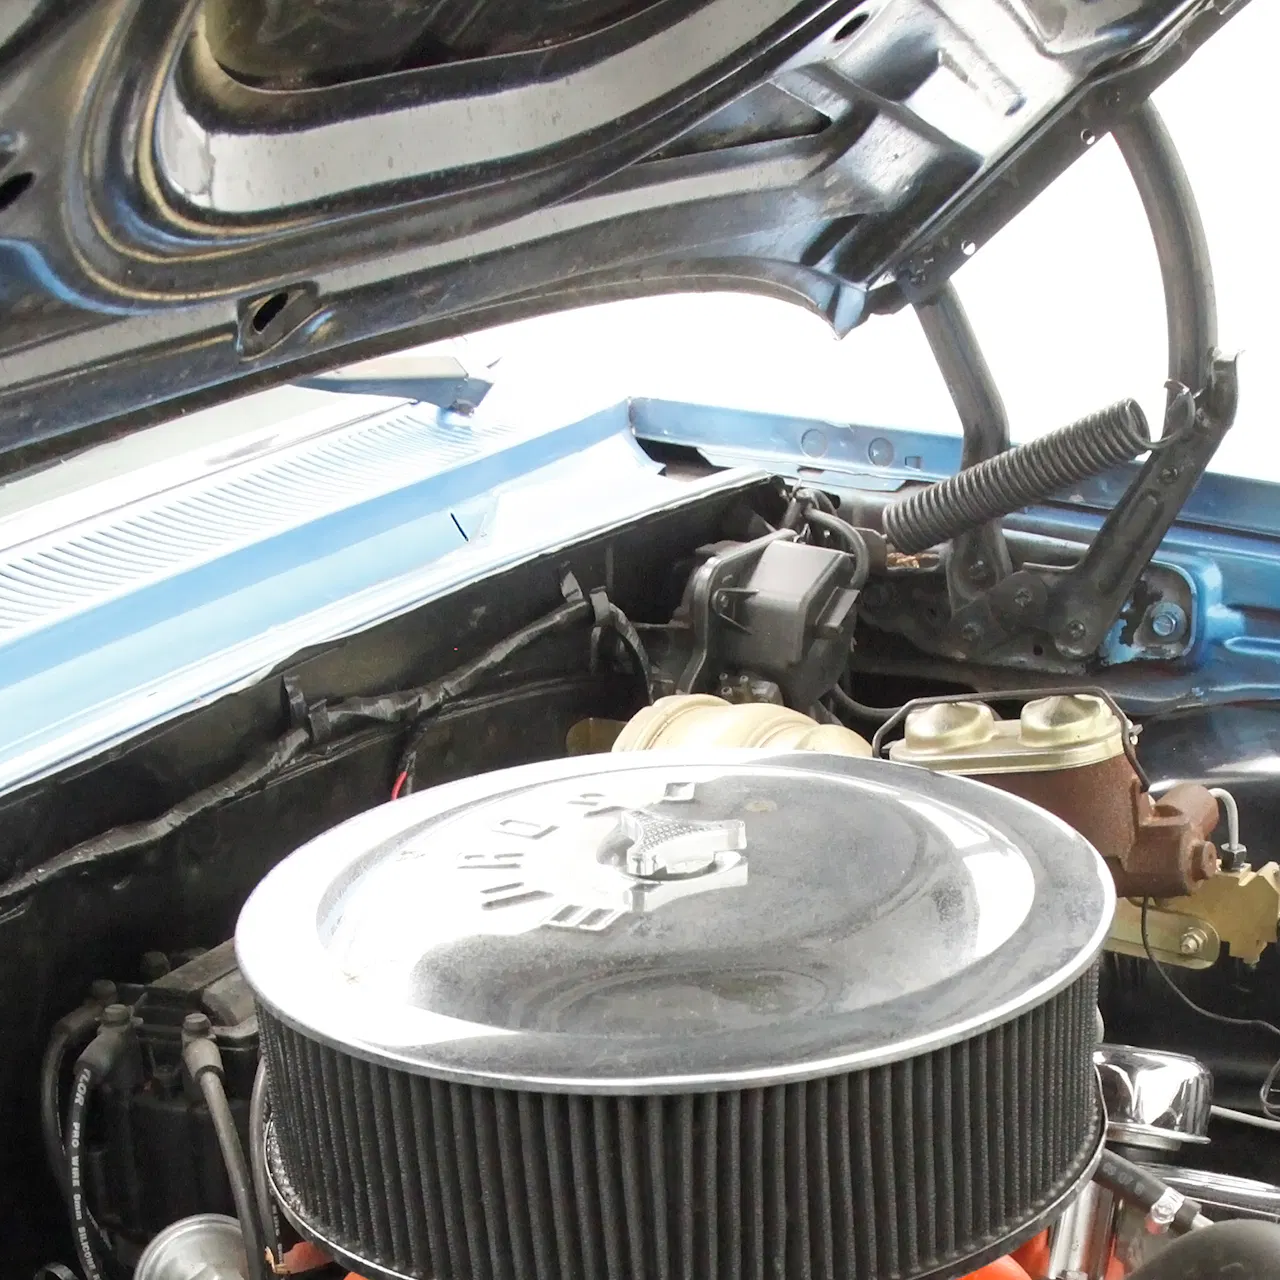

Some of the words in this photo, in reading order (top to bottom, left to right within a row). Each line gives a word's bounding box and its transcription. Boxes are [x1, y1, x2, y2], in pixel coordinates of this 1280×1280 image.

[72, 1121, 81, 1148] PRO
[71, 1155, 81, 1187] WIRE
[77, 1226, 96, 1270] SILICONE
